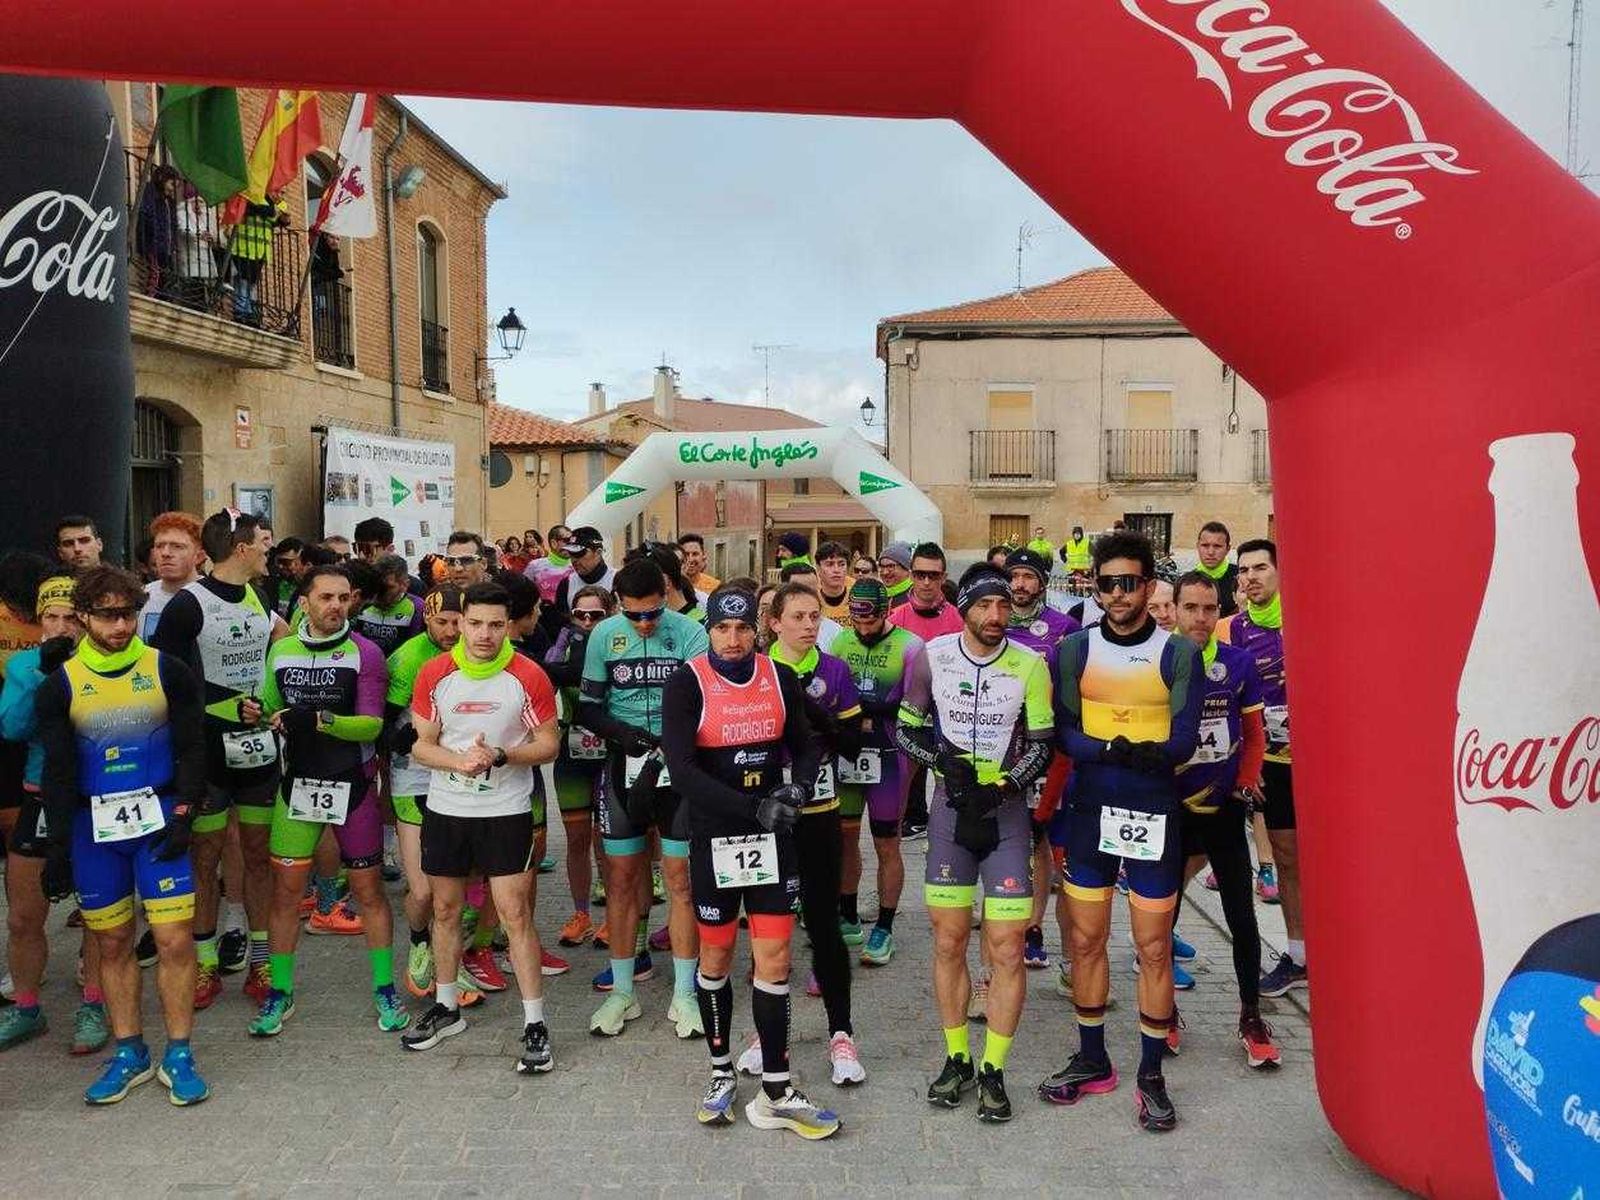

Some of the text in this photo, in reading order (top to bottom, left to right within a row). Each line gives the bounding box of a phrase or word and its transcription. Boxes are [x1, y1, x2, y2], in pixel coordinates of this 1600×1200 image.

[679, 437, 818, 468] El Corte Inglés
[283, 667, 336, 686] CEBALLOS
[241, 738, 265, 755] 35
[310, 792, 334, 809] 13
[115, 803, 143, 824] 41
[1119, 823, 1149, 843] 62
[735, 850, 763, 870] 12
